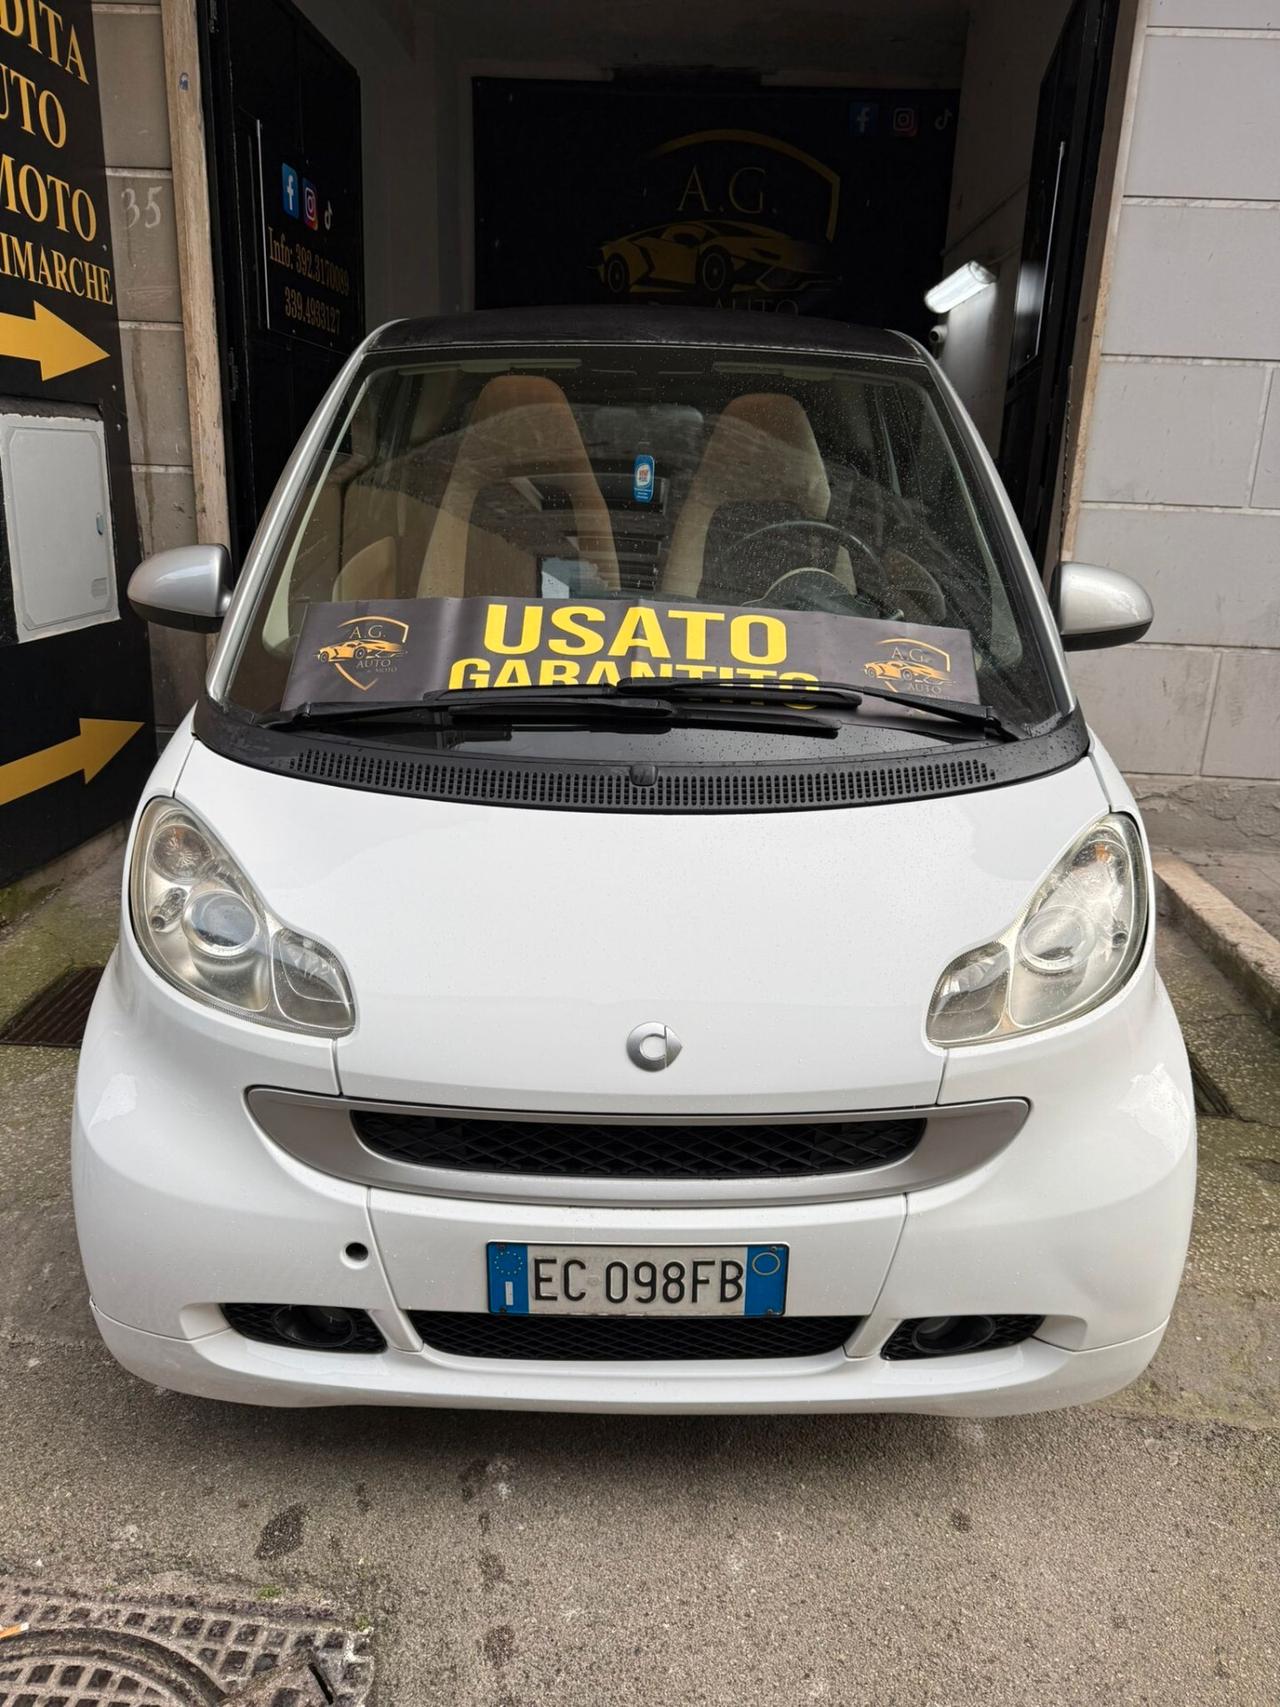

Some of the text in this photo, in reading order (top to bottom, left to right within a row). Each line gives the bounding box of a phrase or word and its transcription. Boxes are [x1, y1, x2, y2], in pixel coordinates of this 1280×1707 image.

[121, 185, 163, 229] 35
[268, 226, 294, 270] Info:
[348, 624, 386, 639] A.G.
[484, 603, 787, 665] USATO
[356, 658, 392, 669] AUTO
[533, 1257, 744, 1305] EC 098FB
